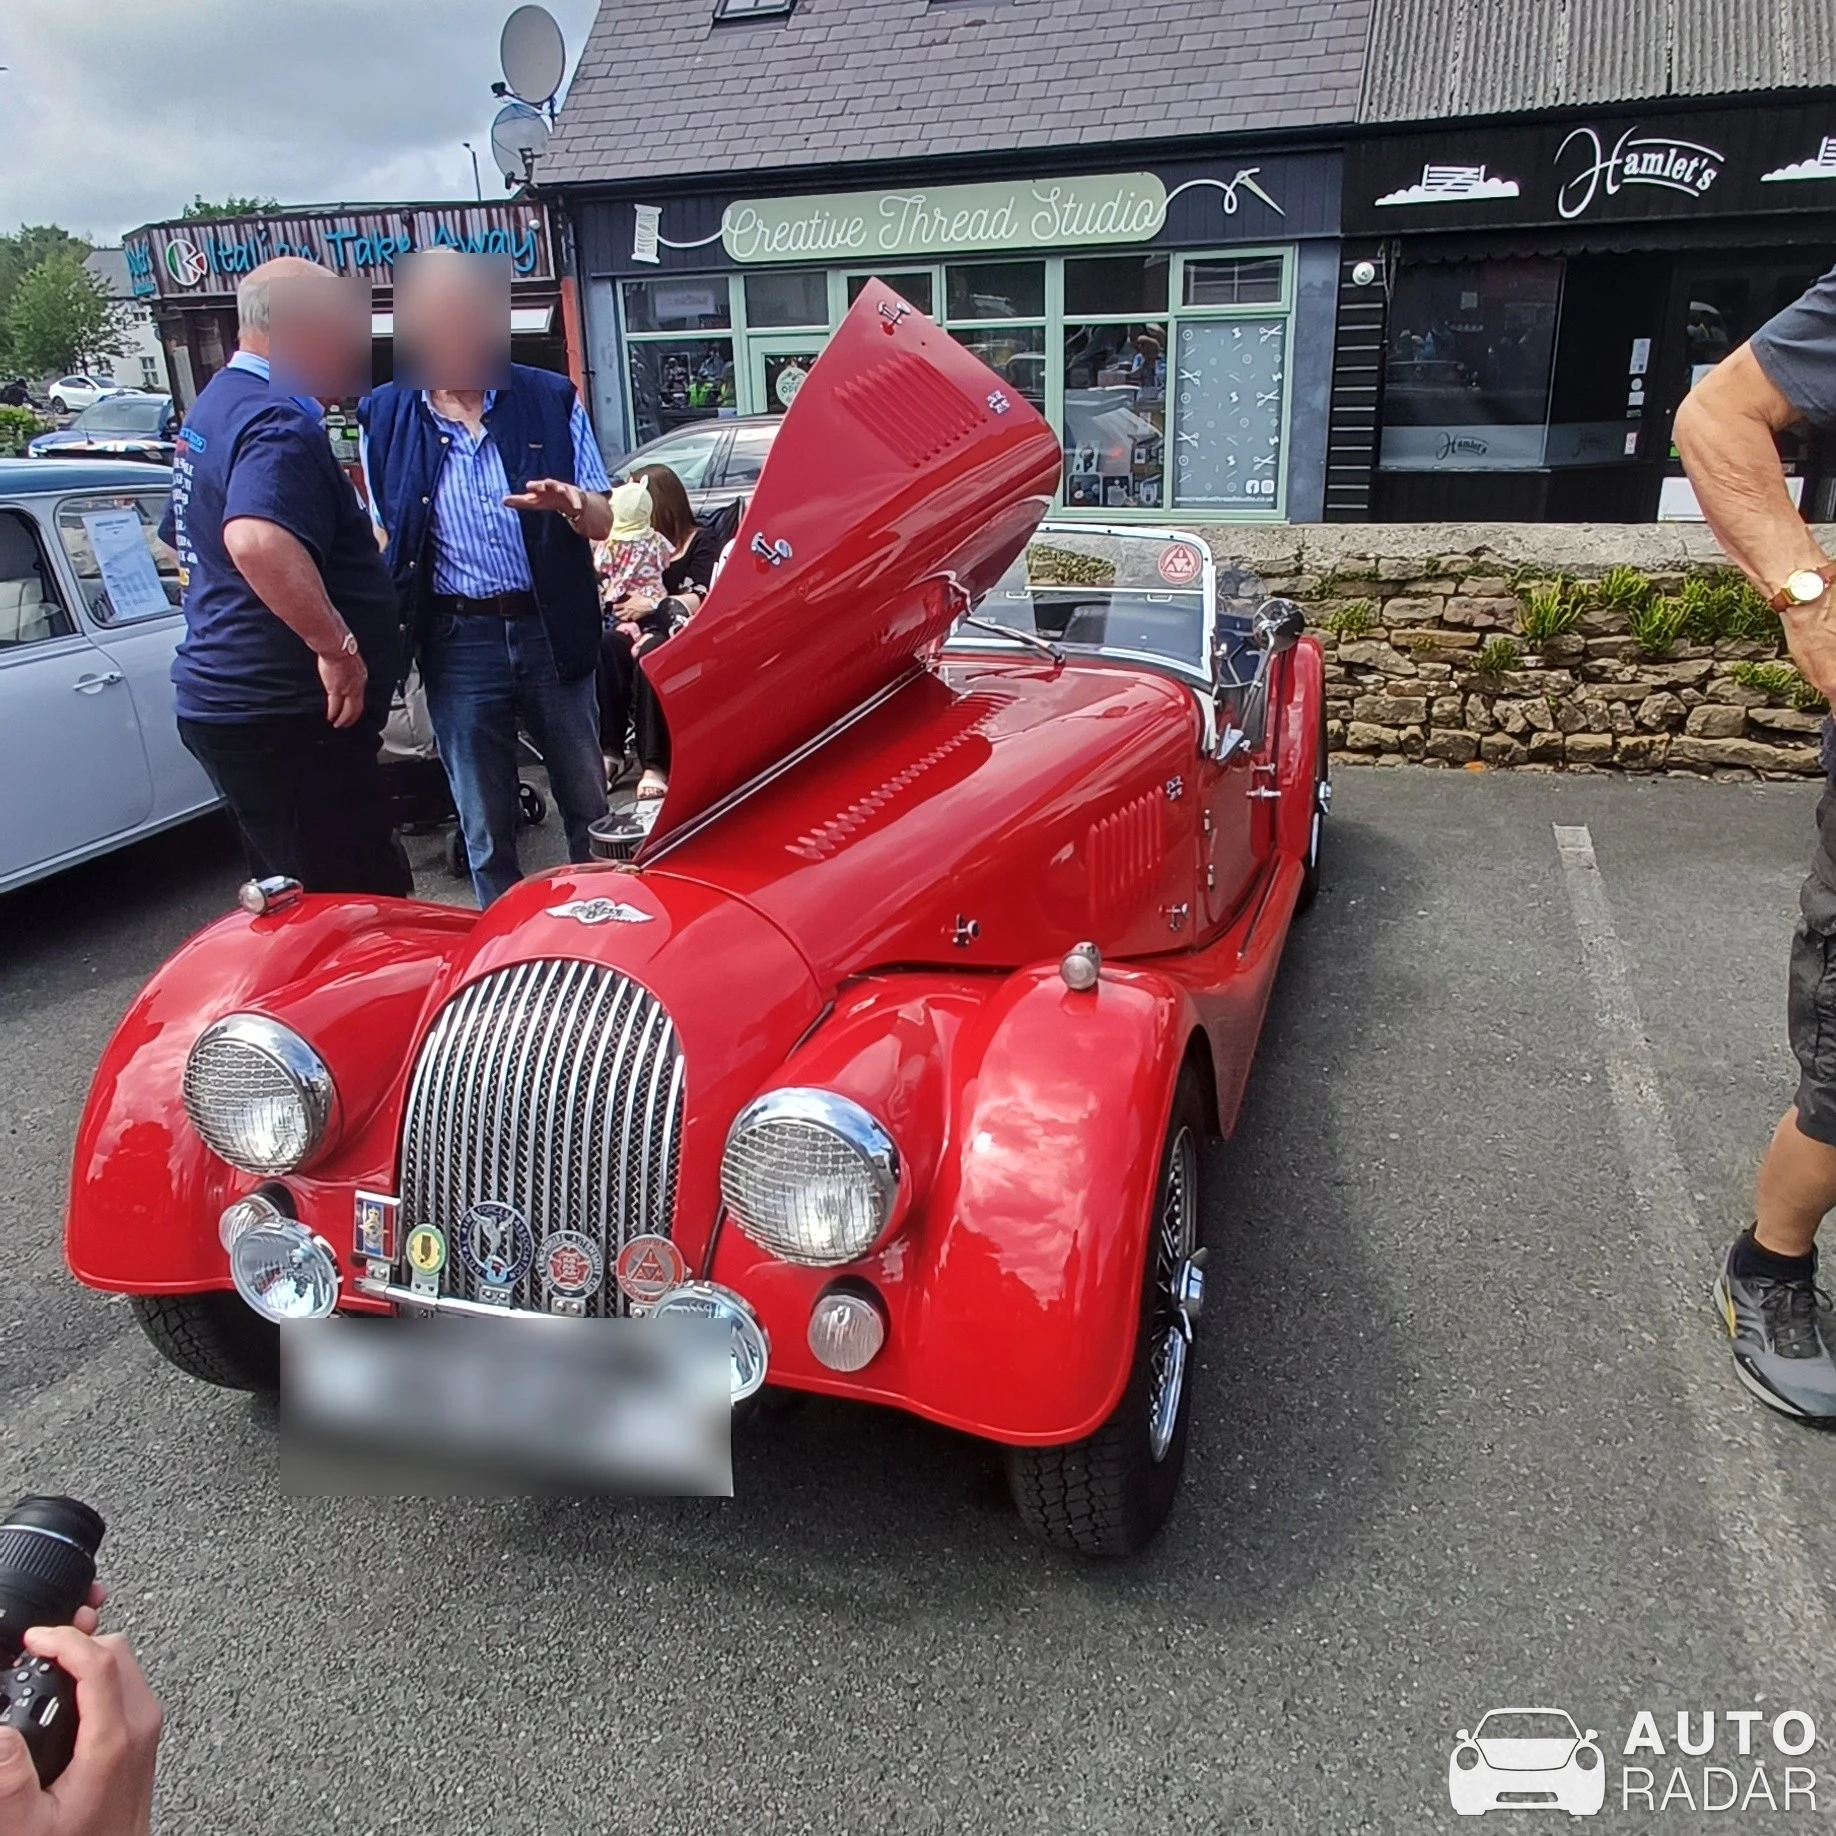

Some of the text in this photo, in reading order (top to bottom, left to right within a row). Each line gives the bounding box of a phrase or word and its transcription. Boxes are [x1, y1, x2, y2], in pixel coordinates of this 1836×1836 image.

[1554, 125, 1717, 219] Hamlet's
[206, 231, 320, 273] Italian
[325, 228, 411, 267] Take
[722, 186, 1167, 258] Creative Thread Studio
